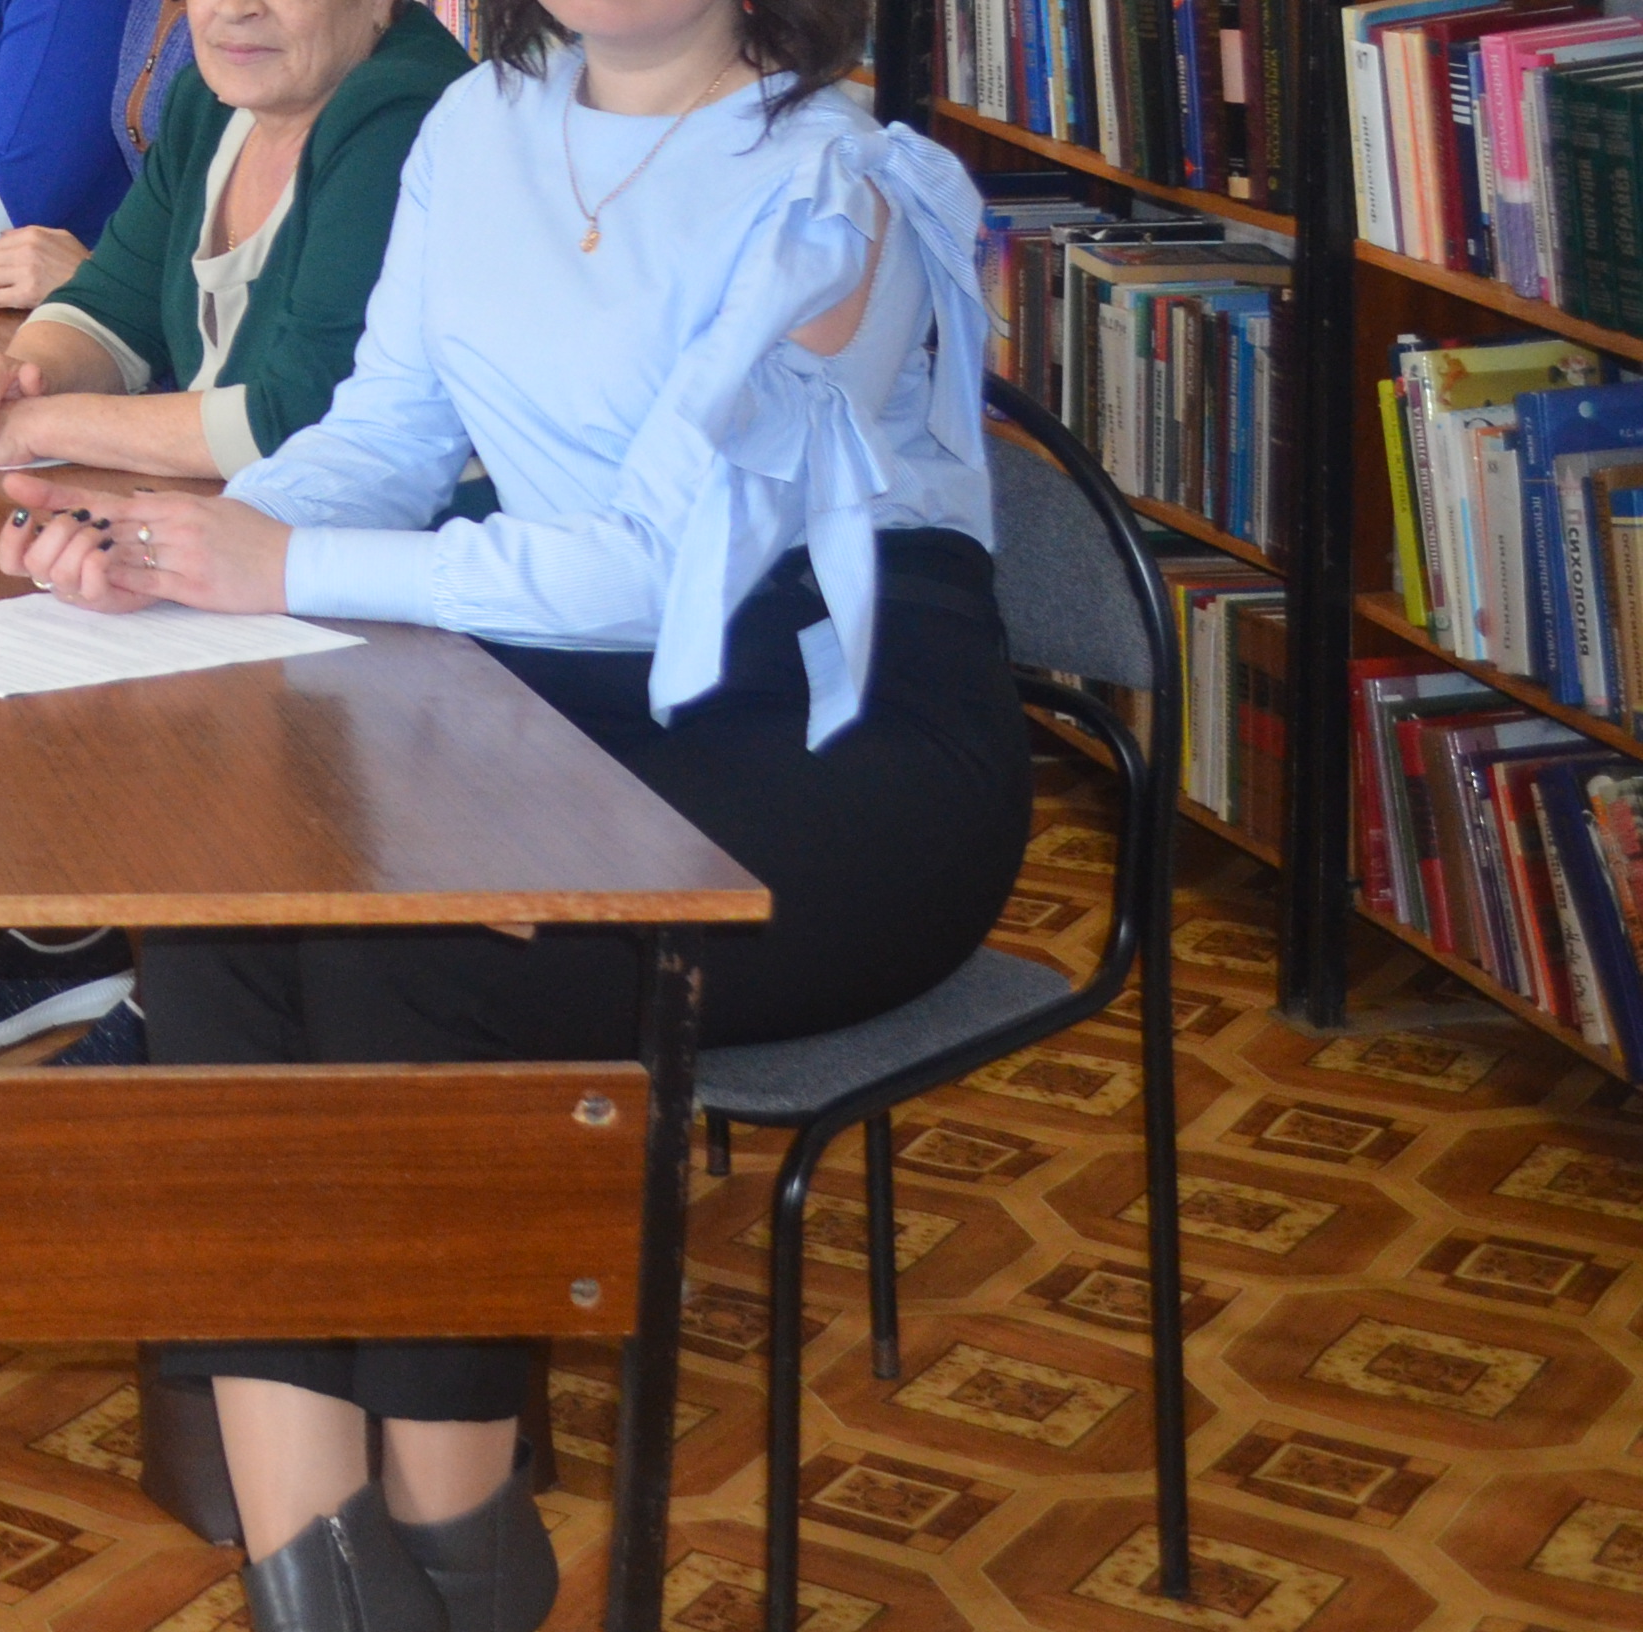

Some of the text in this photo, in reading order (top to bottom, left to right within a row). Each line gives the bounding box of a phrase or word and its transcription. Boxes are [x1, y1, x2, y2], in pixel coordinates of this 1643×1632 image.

[1489, 53, 1510, 169] ФИЛОСОФИЯ
[1362, 115, 1378, 224] Философия
[1154, 417, 1164, 484] РУССКИЙ
[1412, 406, 1428, 462] ЭТИКЕТА
[1496, 534, 1512, 650] Психология
[1531, 495, 1557, 670] ПСИХОЛОГИЧЕСКИЙ СЛОВАРЬ
[1566, 509, 1591, 656] Психология
[1621, 533, 1643, 701] ОСНОВЫ ПСИХОЛОГИИ
